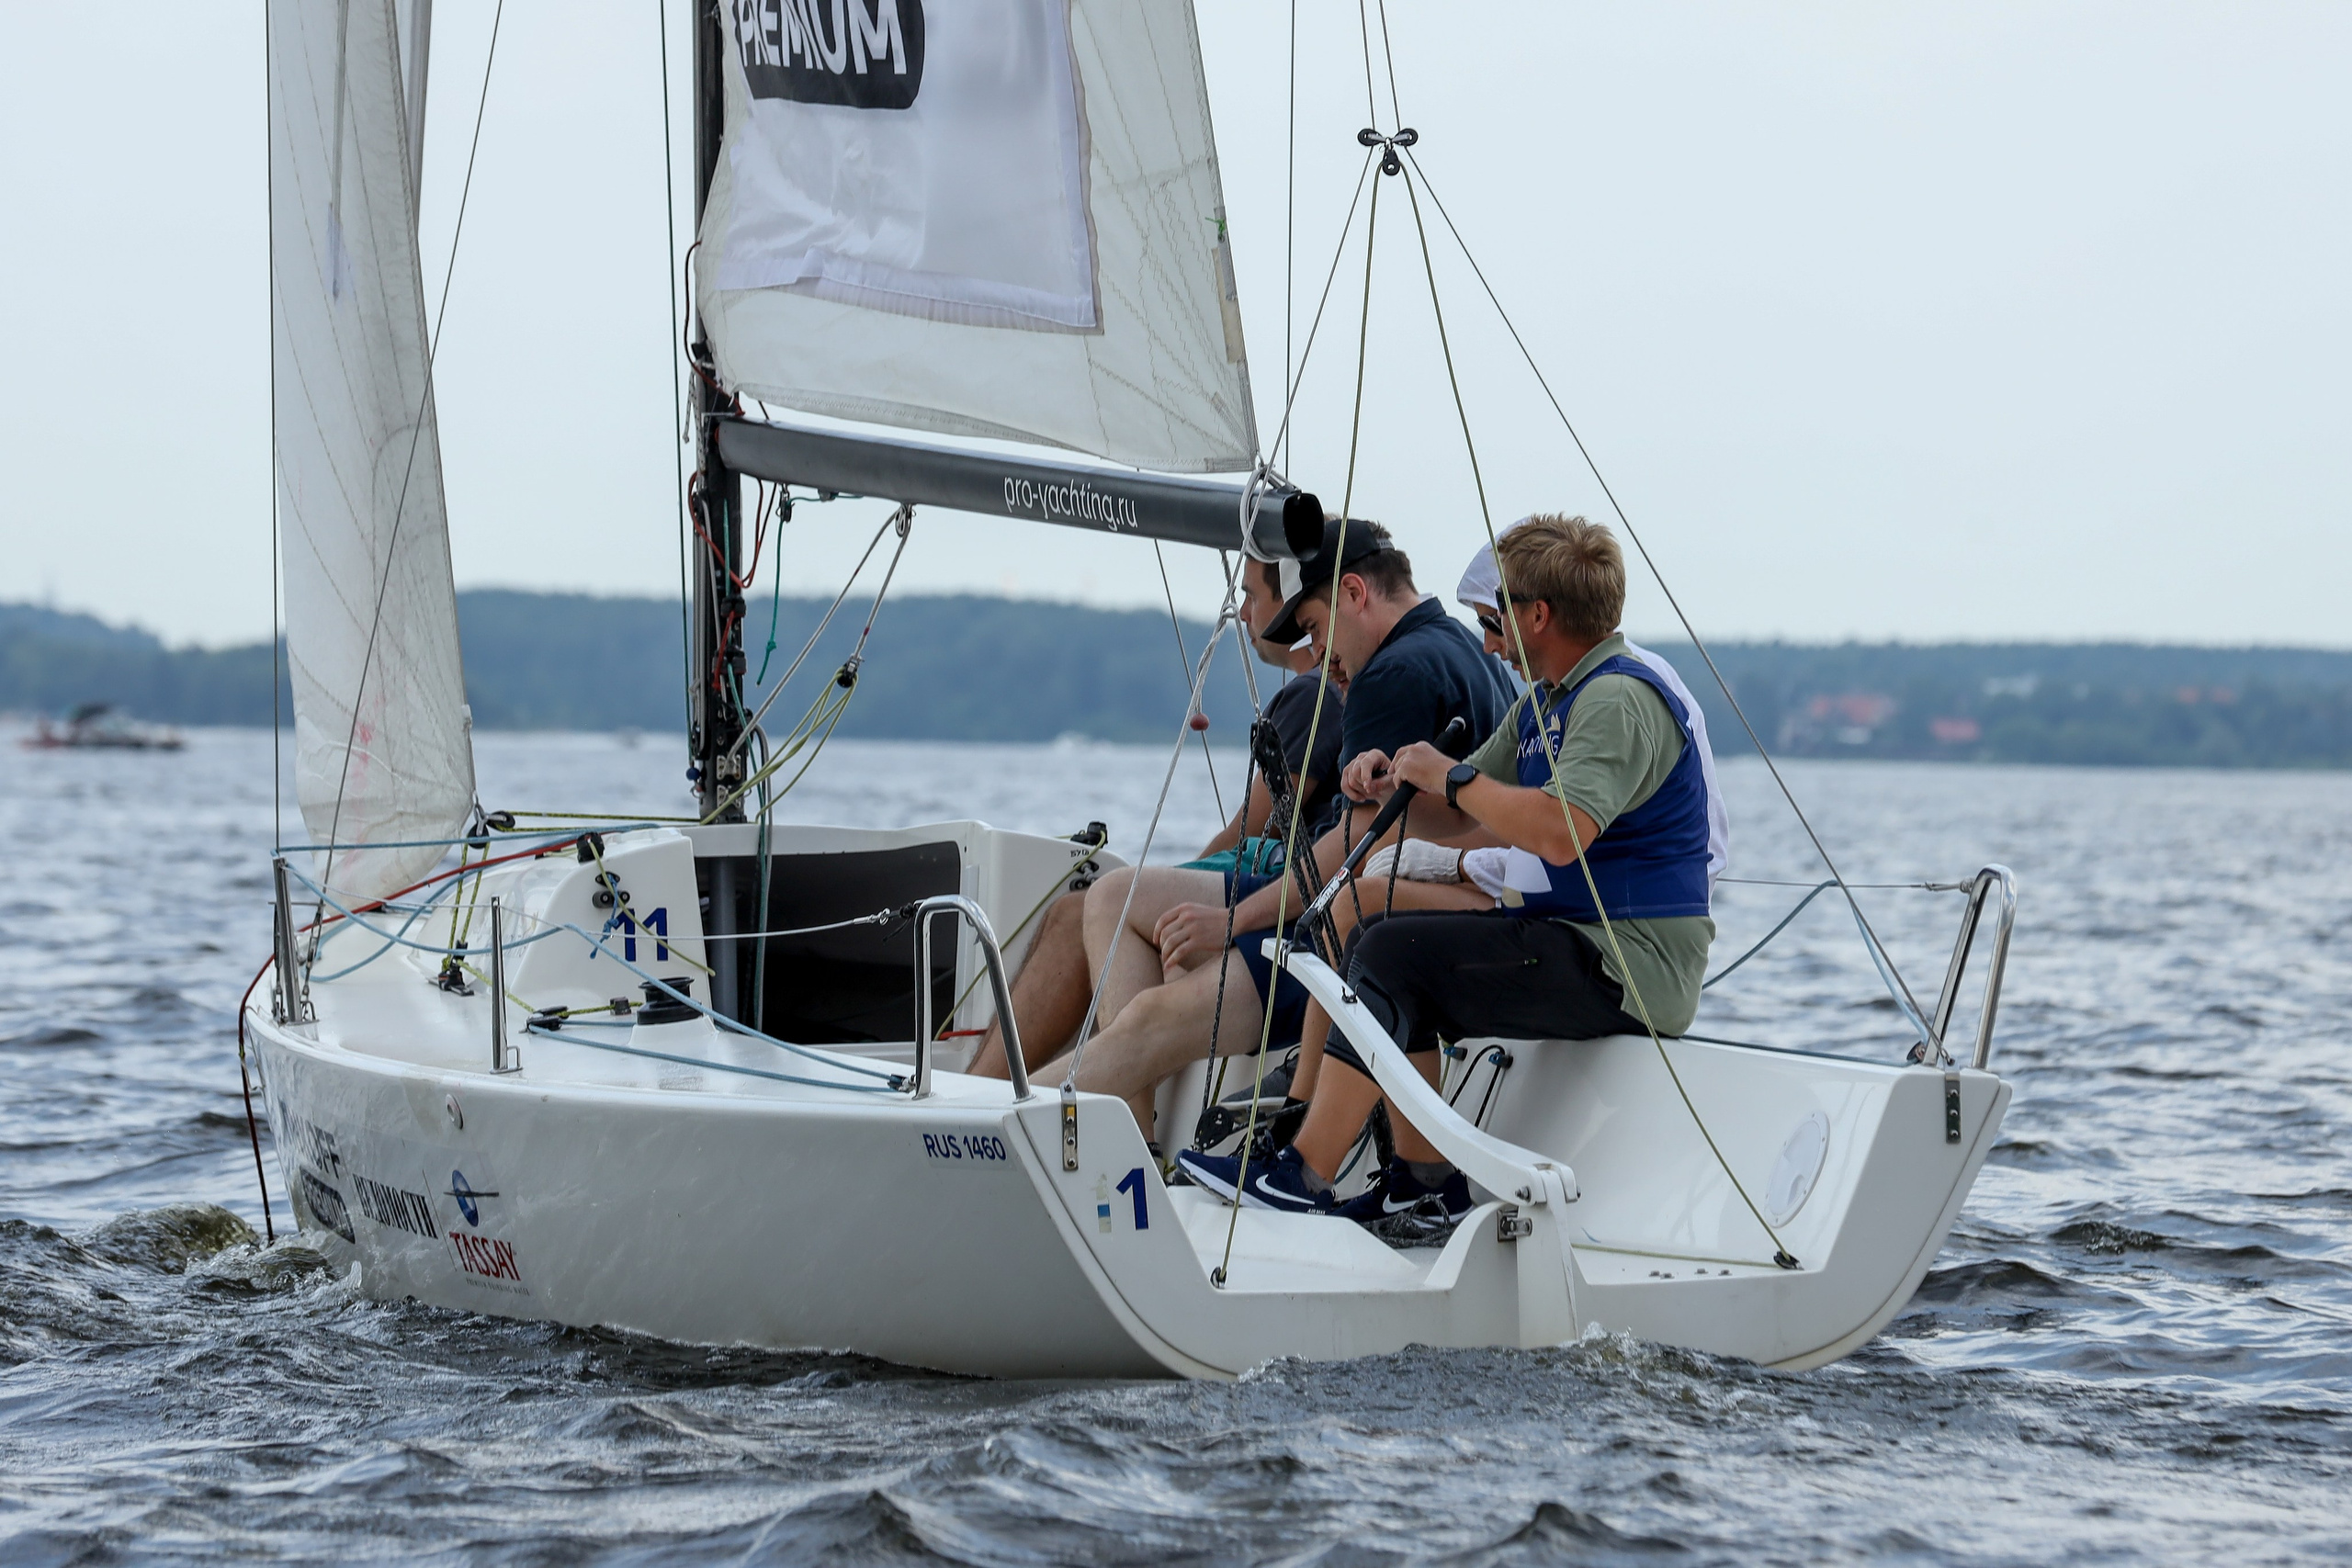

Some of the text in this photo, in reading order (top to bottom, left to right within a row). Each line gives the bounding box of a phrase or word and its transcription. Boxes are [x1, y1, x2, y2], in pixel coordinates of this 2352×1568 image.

[1003, 476, 1138, 532] pro-yachting.ru
[612, 907, 669, 963] 11
[922, 1134, 1007, 1161] RUS 1460
[353, 1172, 439, 1240] ВЕДОМОСТИ
[1115, 1167, 1149, 1231] 1
[449, 1231, 522, 1282] TASSAY
